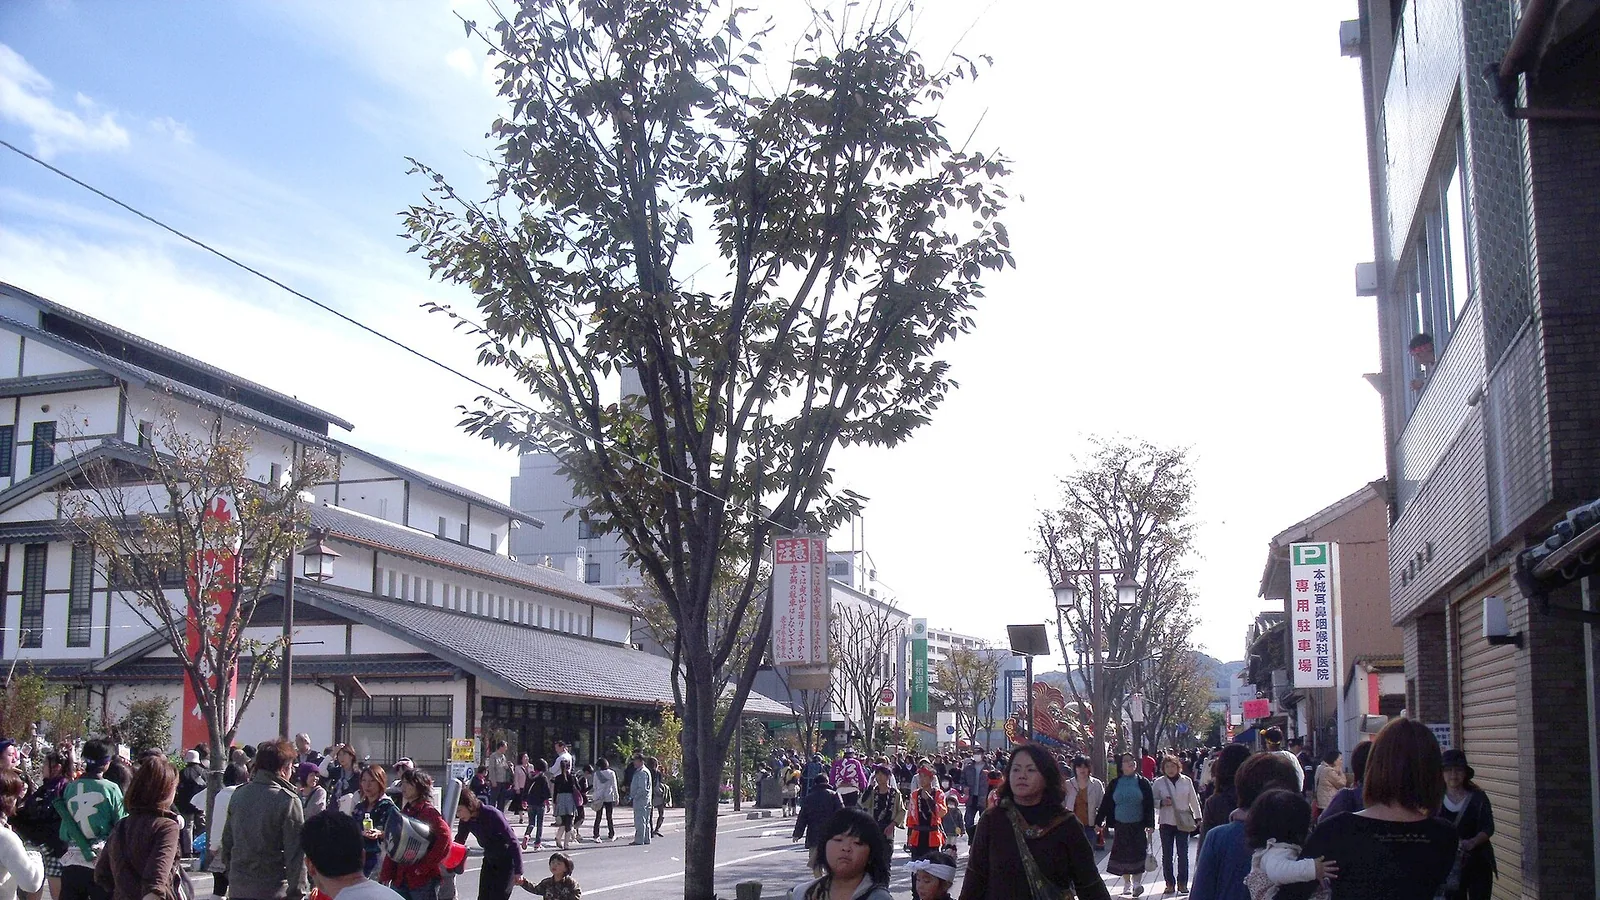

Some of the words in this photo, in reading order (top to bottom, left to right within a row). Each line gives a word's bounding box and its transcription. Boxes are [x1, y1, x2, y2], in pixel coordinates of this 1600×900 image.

[778, 540, 807, 562] 注意
[1300, 546, 1321, 564] P
[1296, 579, 1312, 673] 専用駐車場
[1313, 568, 1329, 680] 本城耳鼻咽喉科医院
